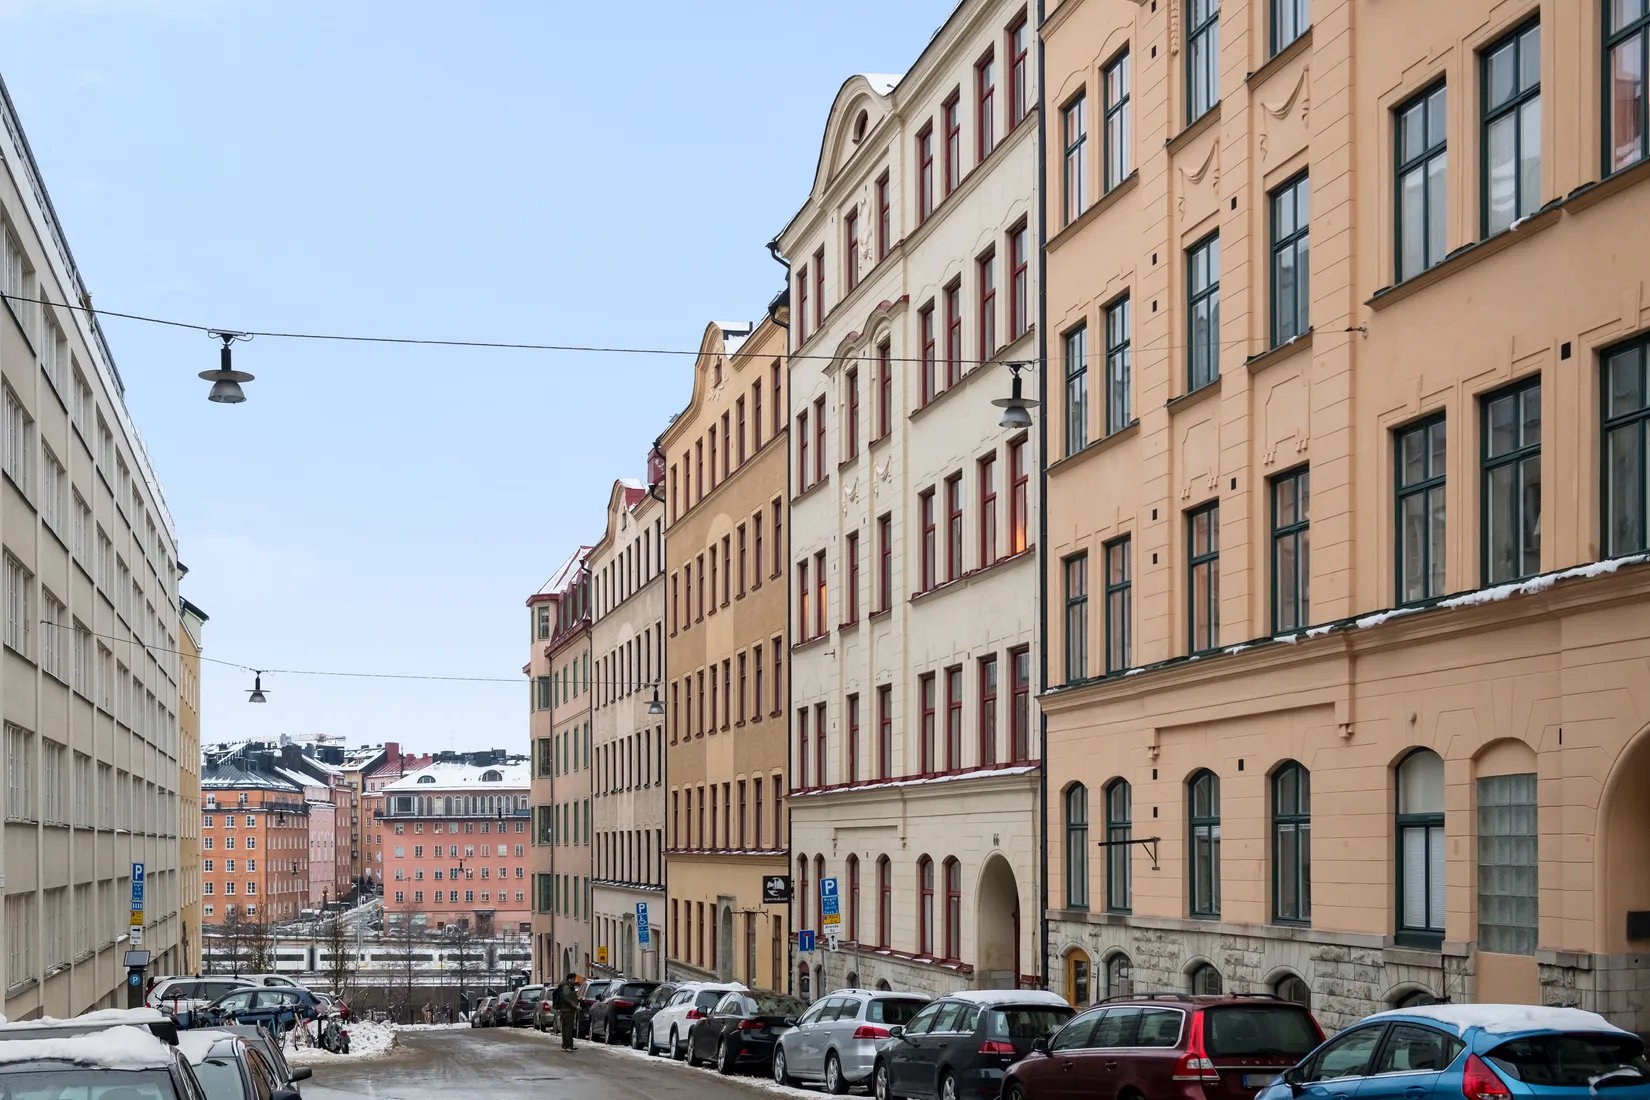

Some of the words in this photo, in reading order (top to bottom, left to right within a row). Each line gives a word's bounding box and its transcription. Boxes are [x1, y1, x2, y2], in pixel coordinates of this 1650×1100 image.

[135, 865, 142, 880] P
[825, 880, 835, 895] P
[638, 904, 645, 913] P
[132, 976, 139, 984] P
